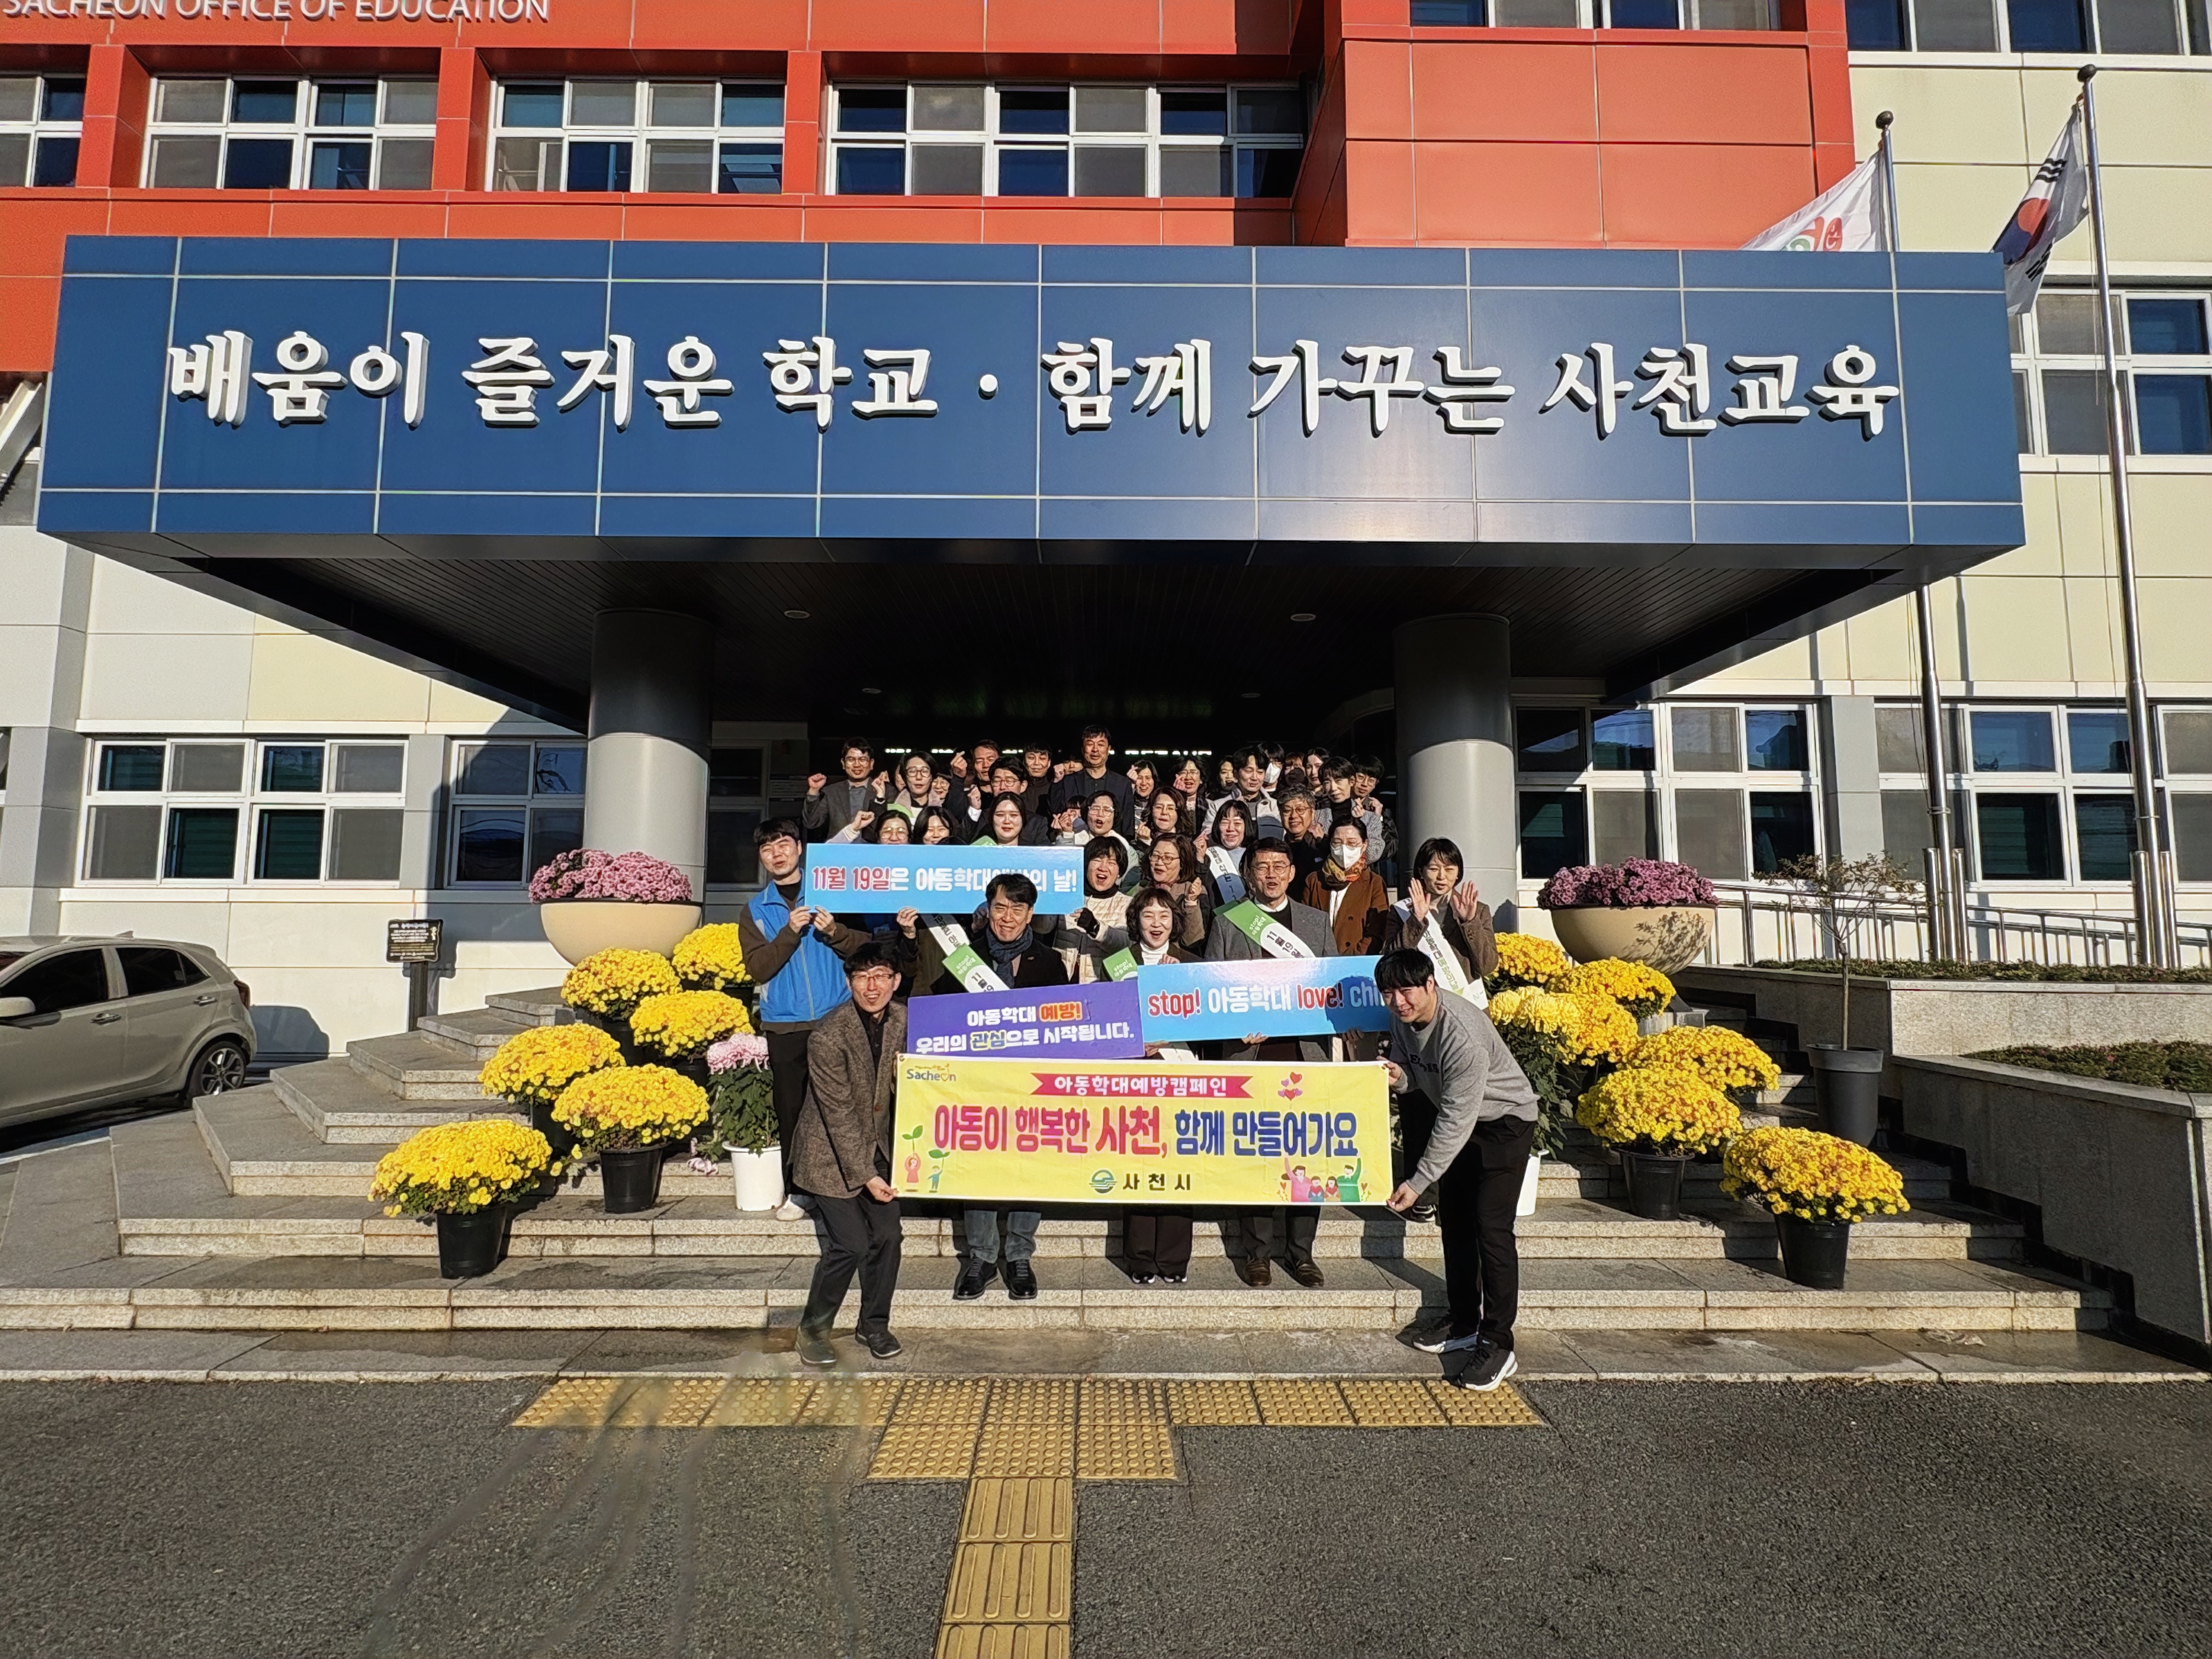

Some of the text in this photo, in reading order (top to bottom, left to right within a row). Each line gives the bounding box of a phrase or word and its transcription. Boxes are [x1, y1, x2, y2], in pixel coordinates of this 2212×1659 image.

[300, 0, 346, 19] OF
[168, 330, 430, 427] 배움이
[462, 335, 734, 428] 즐거운
[763, 336, 939, 428] 학교
[1041, 338, 1211, 432] 함께
[1250, 339, 1515, 433] 가꾸는
[1543, 342, 1899, 436] 사천교육
[812, 866, 1077, 893] 11월 19일은 아동학대의 날!
[967, 1001, 1083, 1027] 아동학대 예방!
[1147, 988, 1201, 1019] stop!
[1208, 984, 1291, 1013] 아동학대
[1296, 982, 1345, 1011] love!
[916, 1022, 1135, 1054] 우리의 관심으로 시작됩니다.
[1054, 1075, 1227, 1097] 아동학대예방캠페인
[934, 1104, 1358, 1159] 아동이 행복한 사천, 함께 만들어가요
